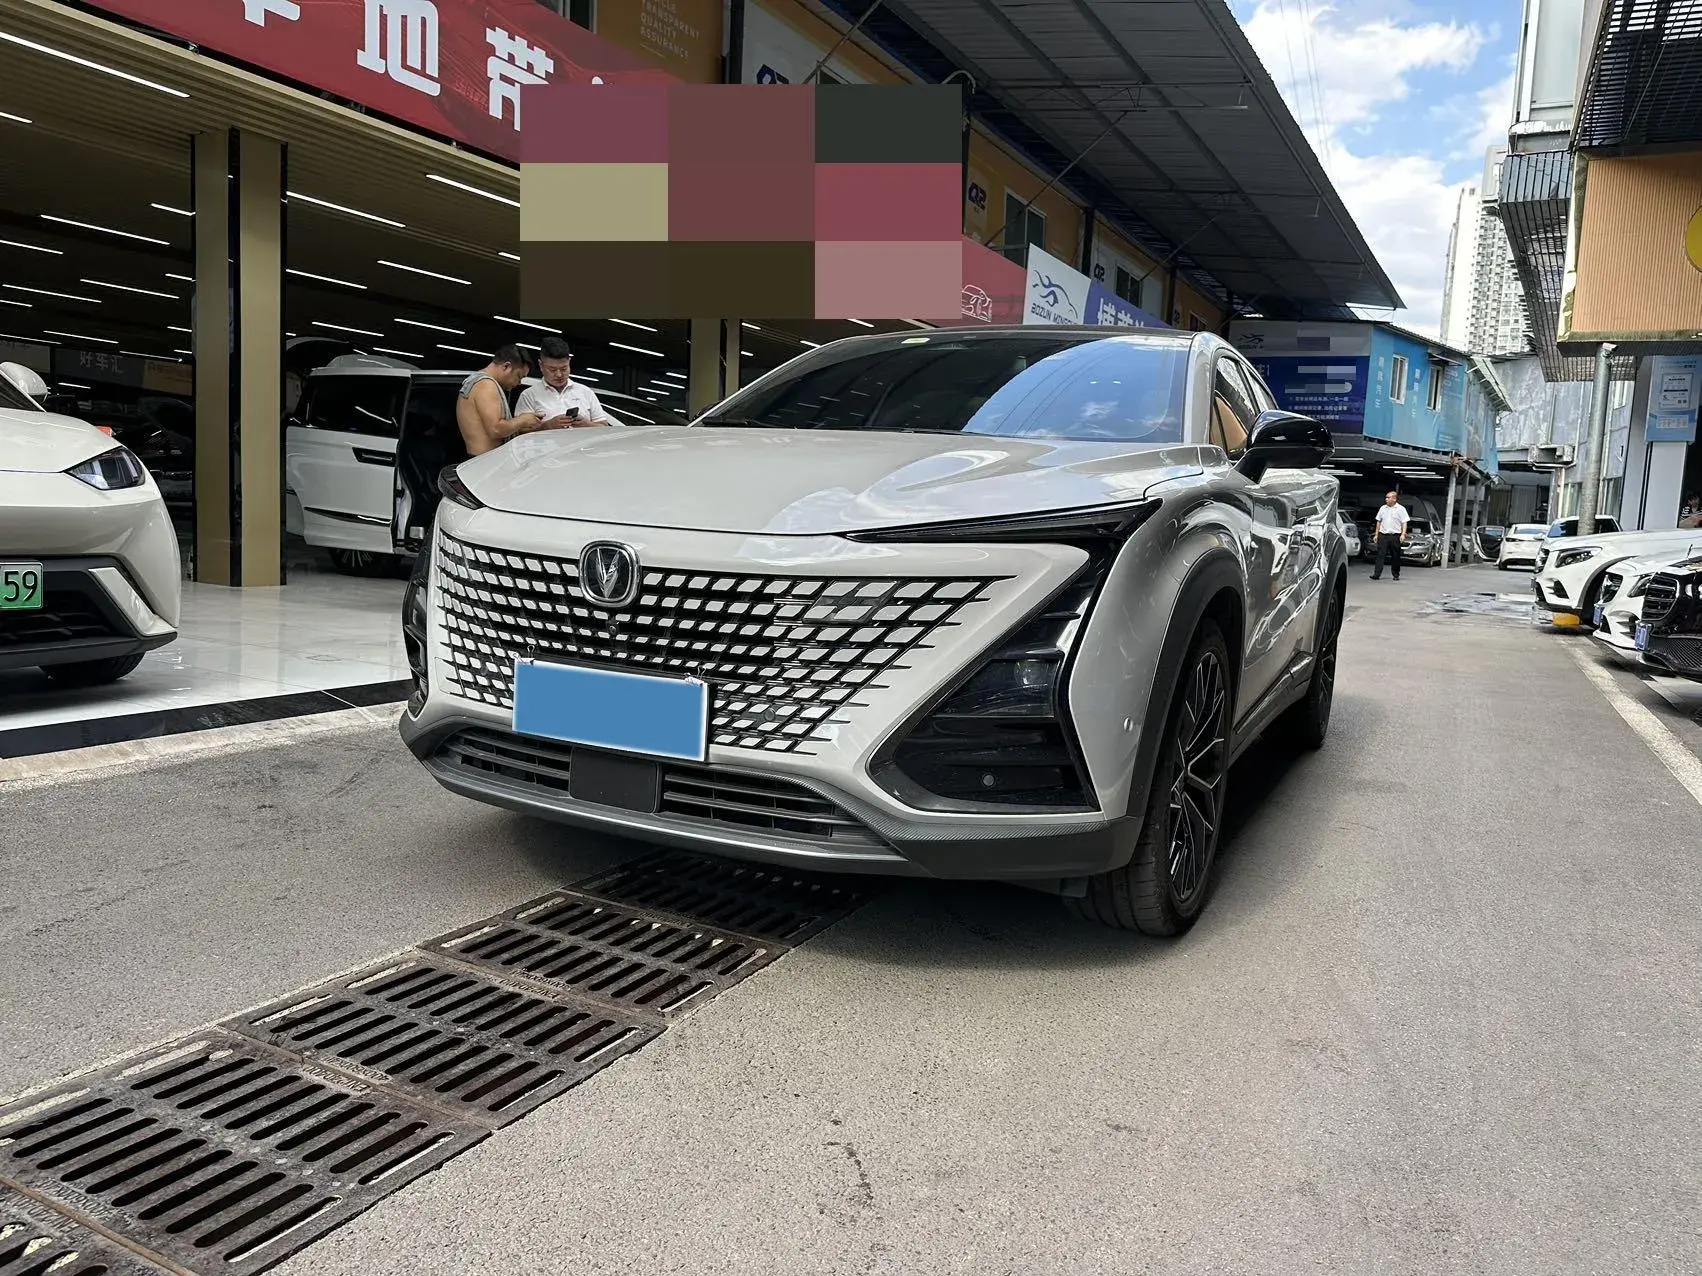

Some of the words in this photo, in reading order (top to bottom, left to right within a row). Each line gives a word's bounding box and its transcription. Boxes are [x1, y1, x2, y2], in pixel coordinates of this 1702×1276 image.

[640, 12, 677, 39] QUALITY
[640, 26, 688, 60] ASSURANCE
[2, 569, 39, 602] 59
